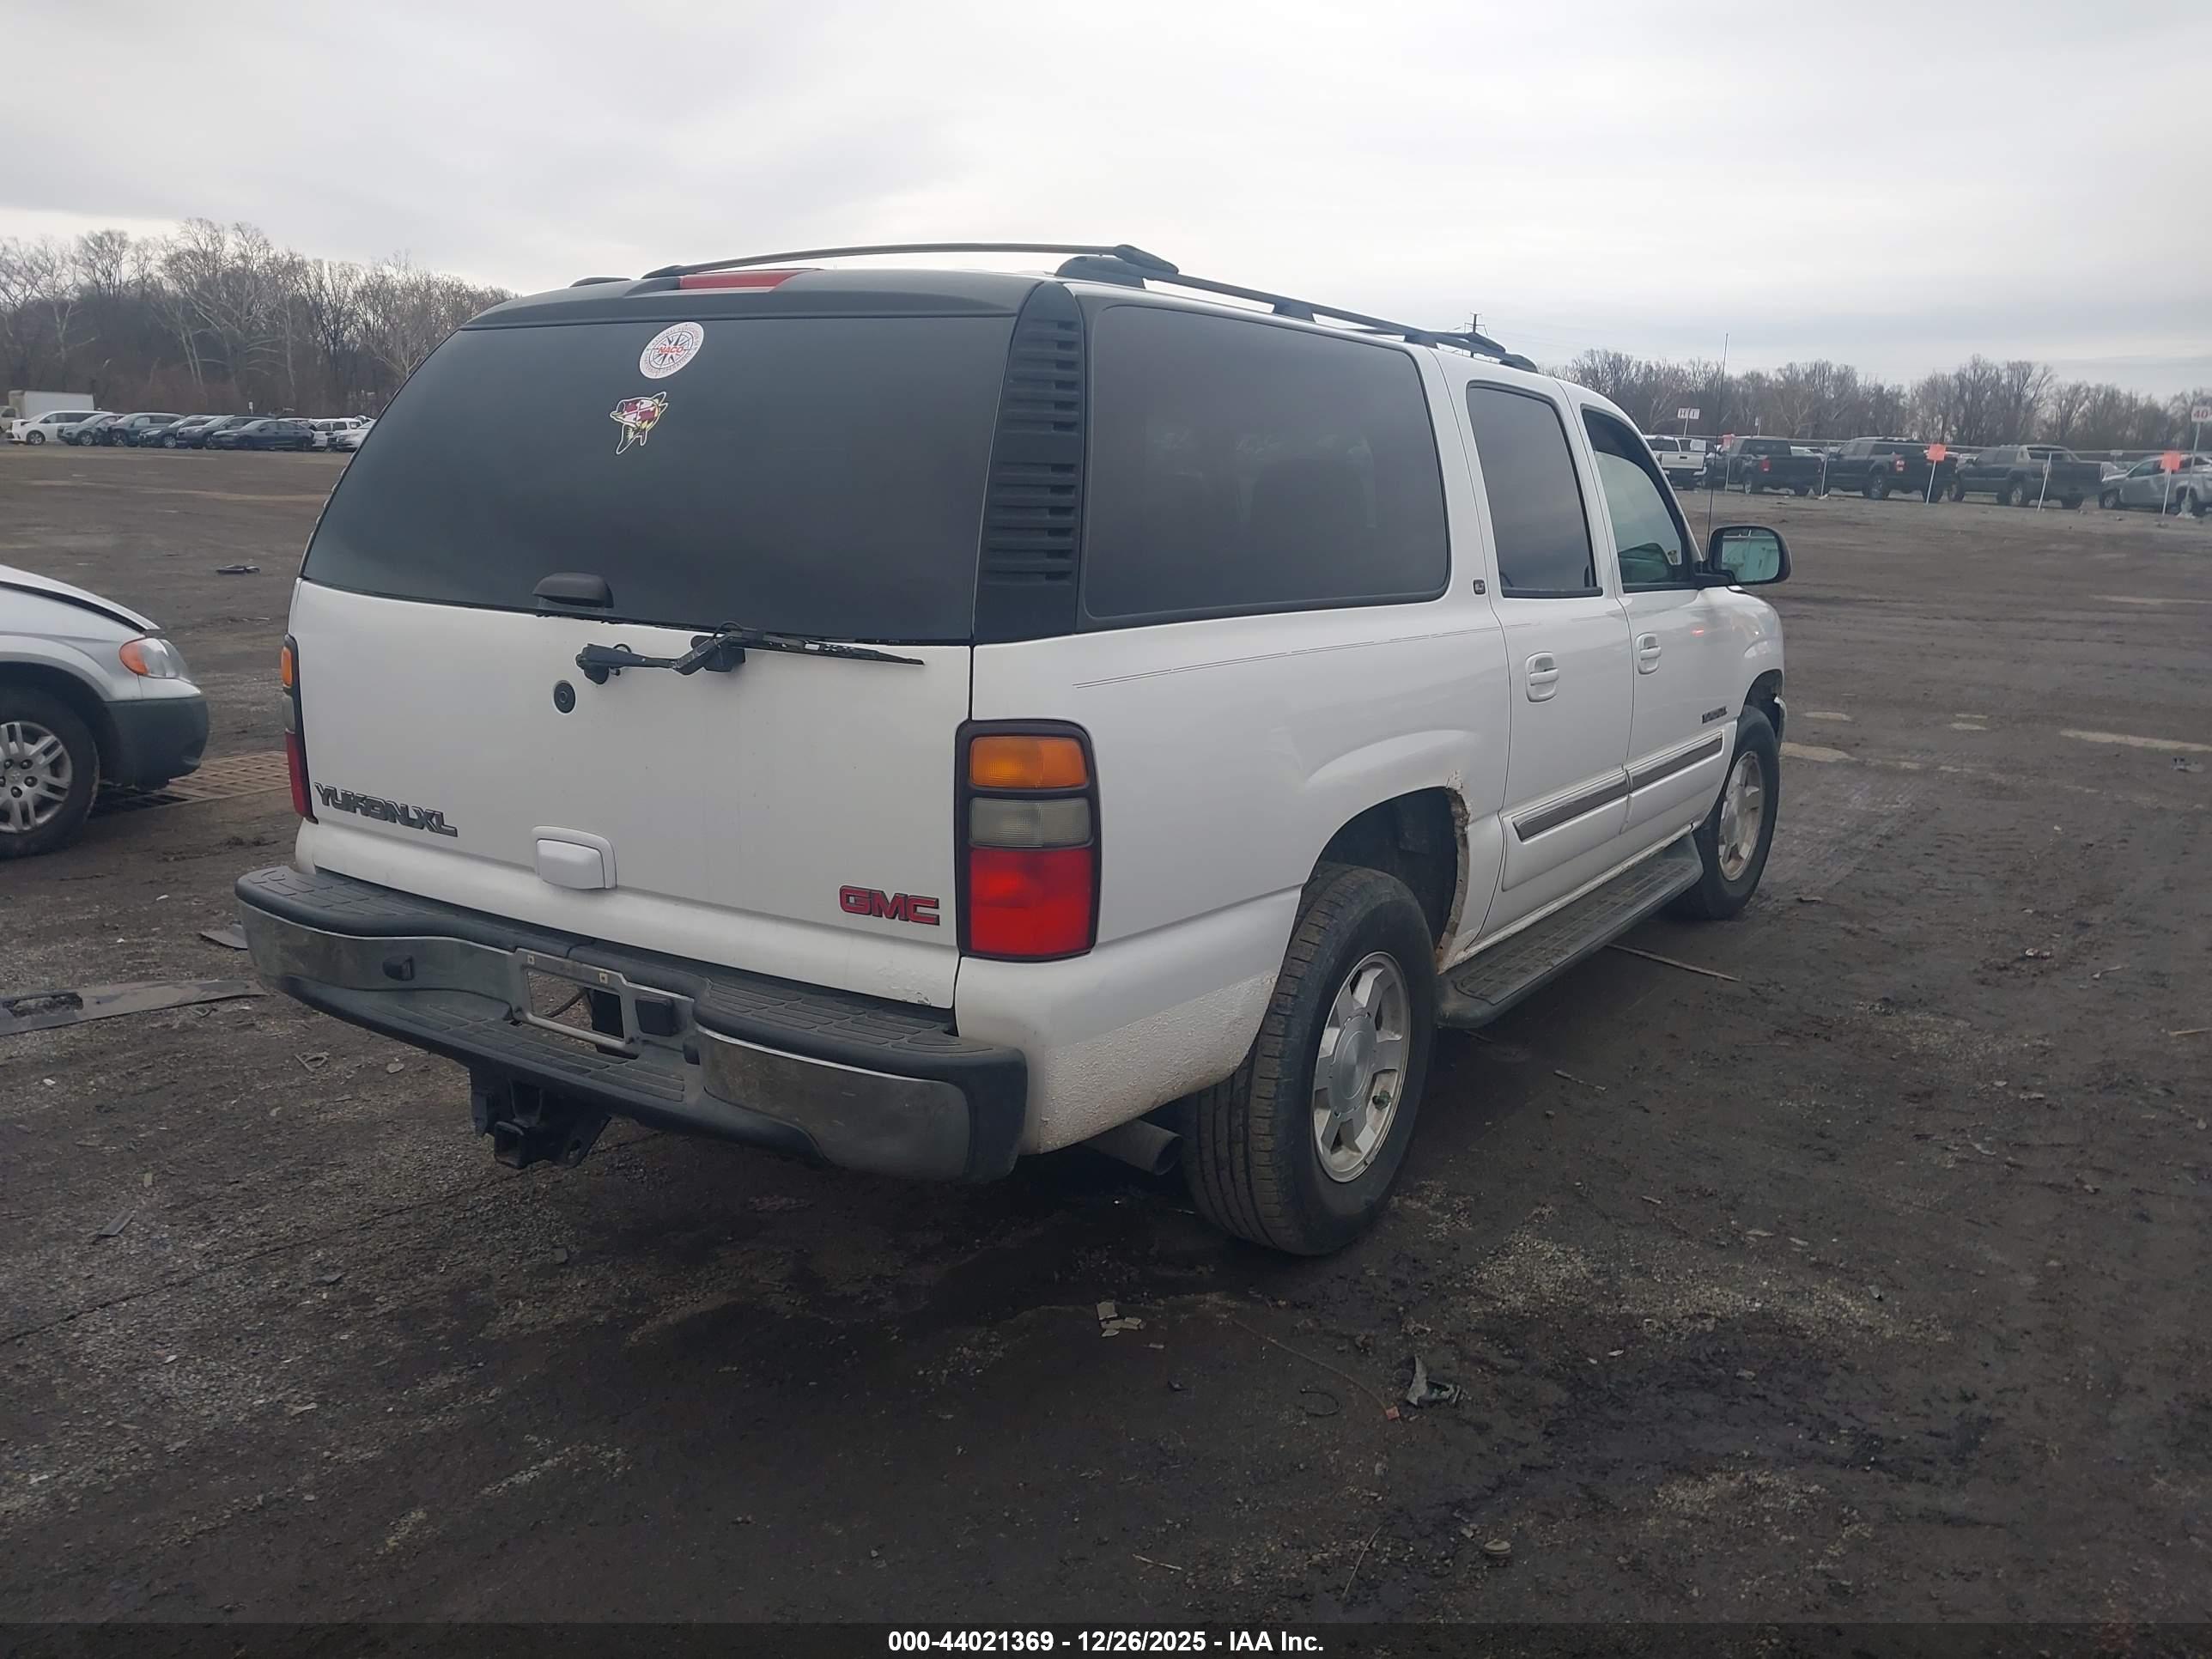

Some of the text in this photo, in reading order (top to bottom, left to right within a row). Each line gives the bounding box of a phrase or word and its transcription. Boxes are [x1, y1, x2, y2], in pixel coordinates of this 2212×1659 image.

[313, 781, 459, 837] YUKON XL
[839, 885, 939, 926] GMC
